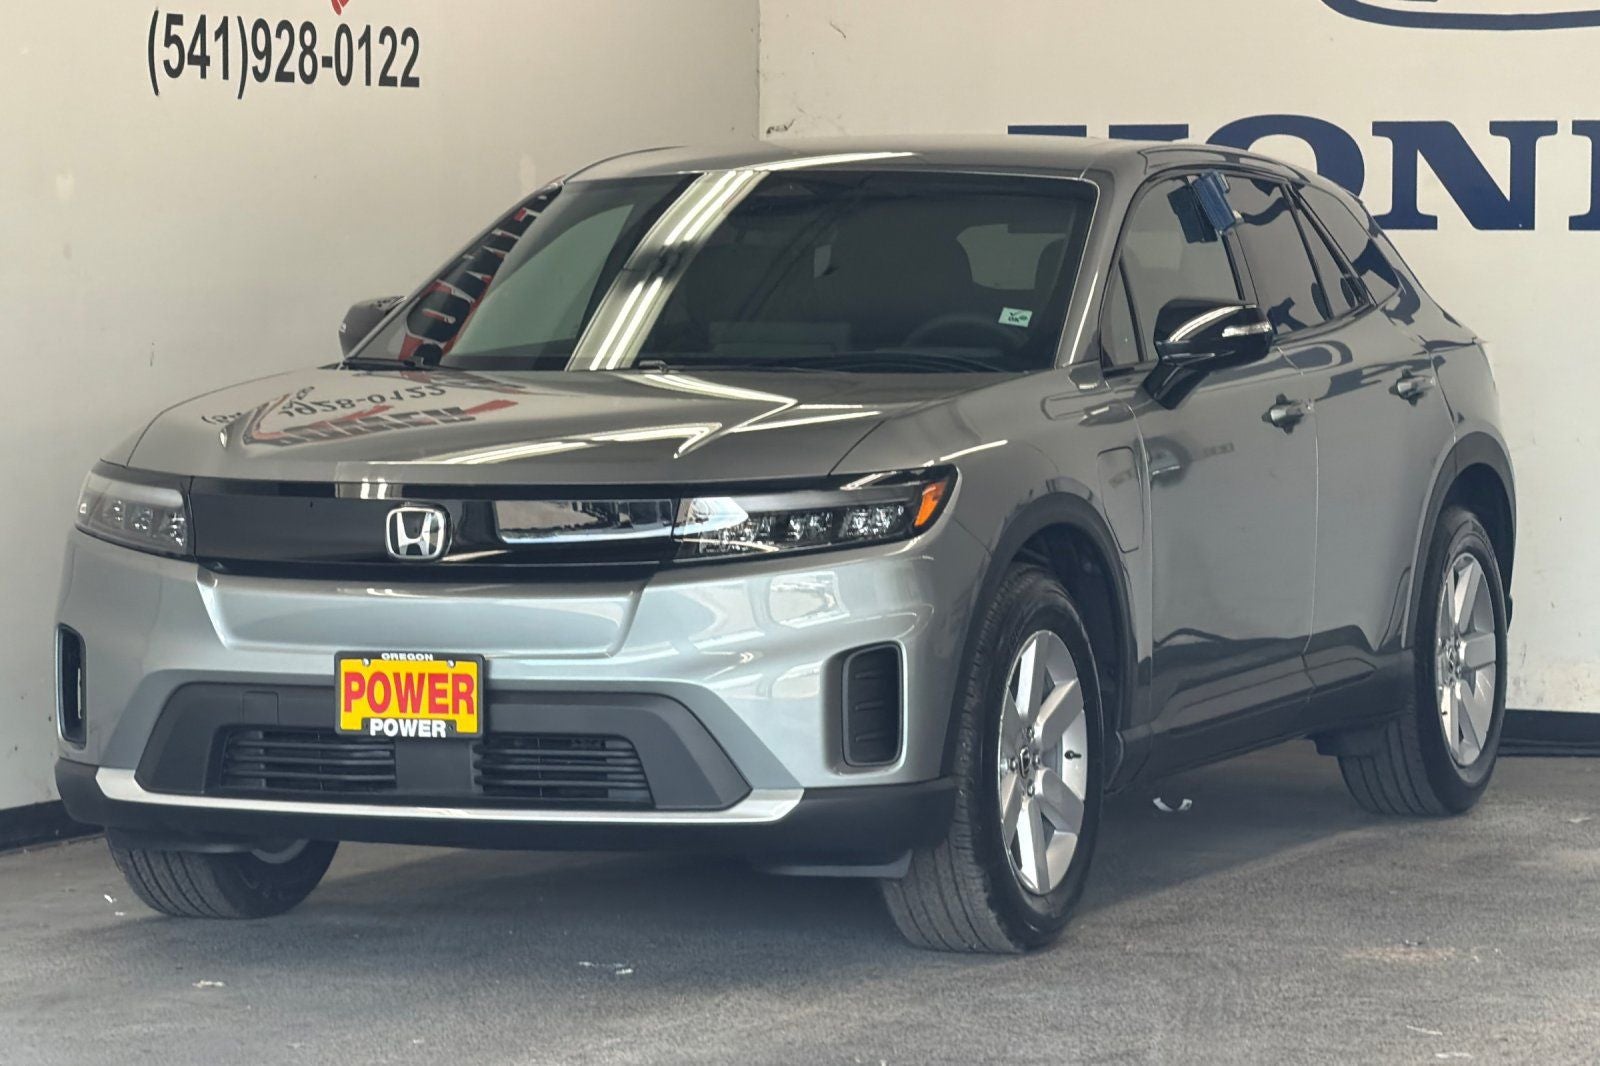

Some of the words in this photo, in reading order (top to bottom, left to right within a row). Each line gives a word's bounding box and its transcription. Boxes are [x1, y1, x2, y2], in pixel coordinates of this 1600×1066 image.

[147, 10, 420, 99] (541)928-0122
[381, 653, 434, 661] OREGON
[343, 671, 475, 715] POWER
[370, 718, 446, 738] POWER
